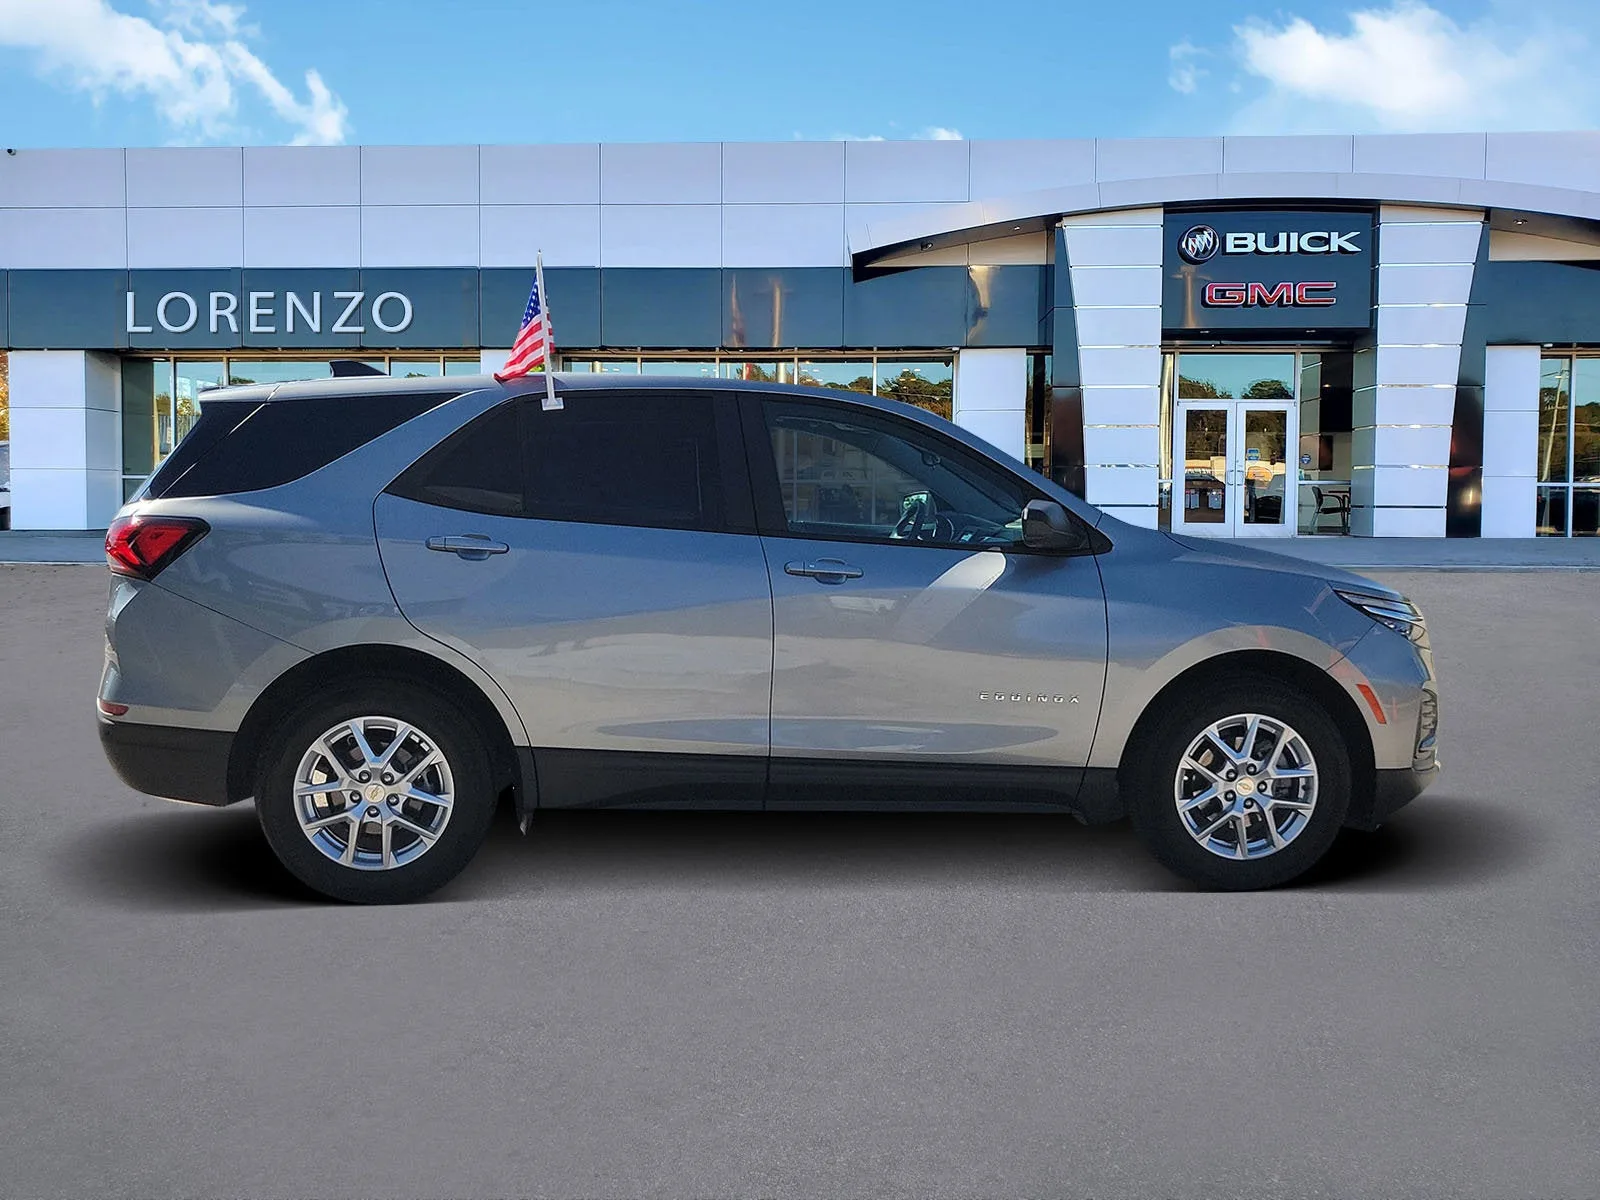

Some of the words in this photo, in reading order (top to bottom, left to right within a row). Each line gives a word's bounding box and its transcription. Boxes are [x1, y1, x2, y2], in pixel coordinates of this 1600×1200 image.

[1226, 231, 1362, 253] BUICK
[1206, 282, 1337, 305] GMC
[126, 291, 414, 333] LORENZO
[979, 691, 1080, 703] EQUINOX
